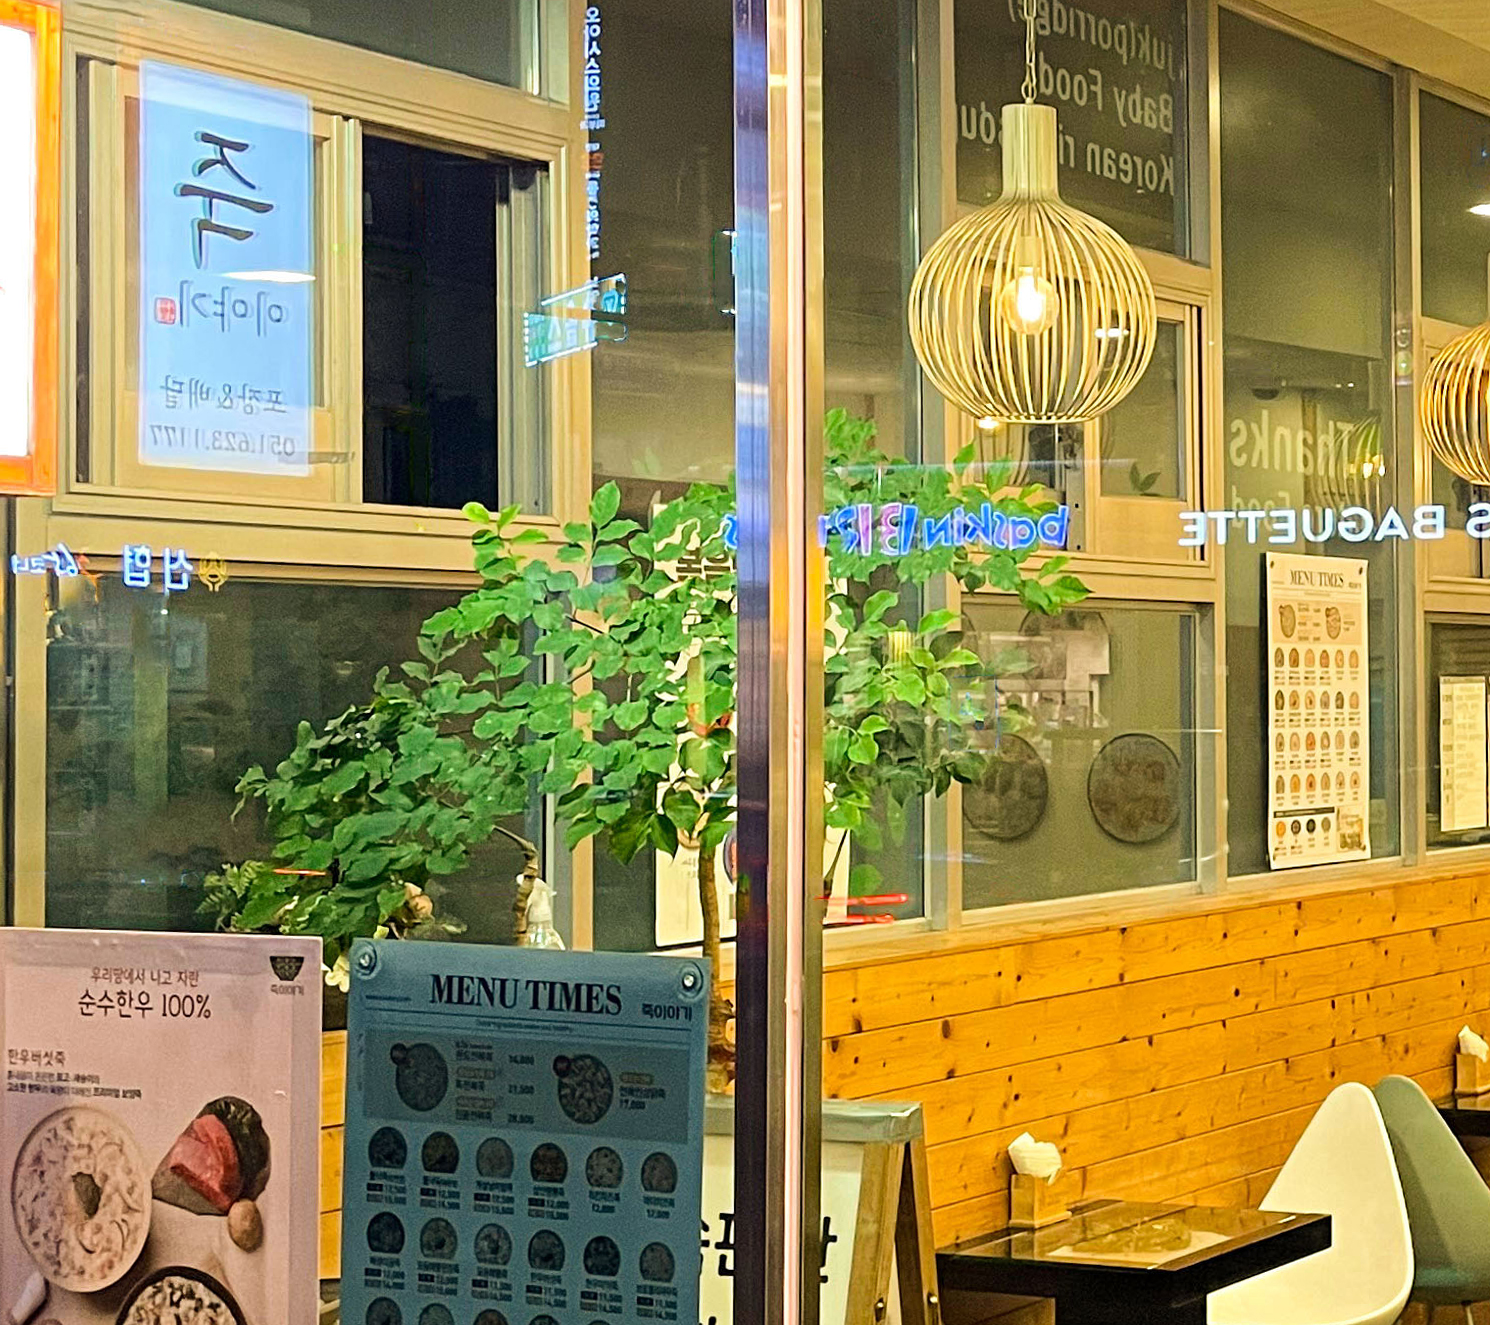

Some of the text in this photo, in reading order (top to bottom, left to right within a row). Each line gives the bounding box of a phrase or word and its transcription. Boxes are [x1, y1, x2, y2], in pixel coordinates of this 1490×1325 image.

[1289, 569, 1315, 587] MENU
[1317, 571, 1344, 589] TIMES
[78, 989, 212, 1019] 순수한우 100%
[429, 973, 624, 1017] MENU TIMES
[642, 1002, 693, 1022] 죽이야기
